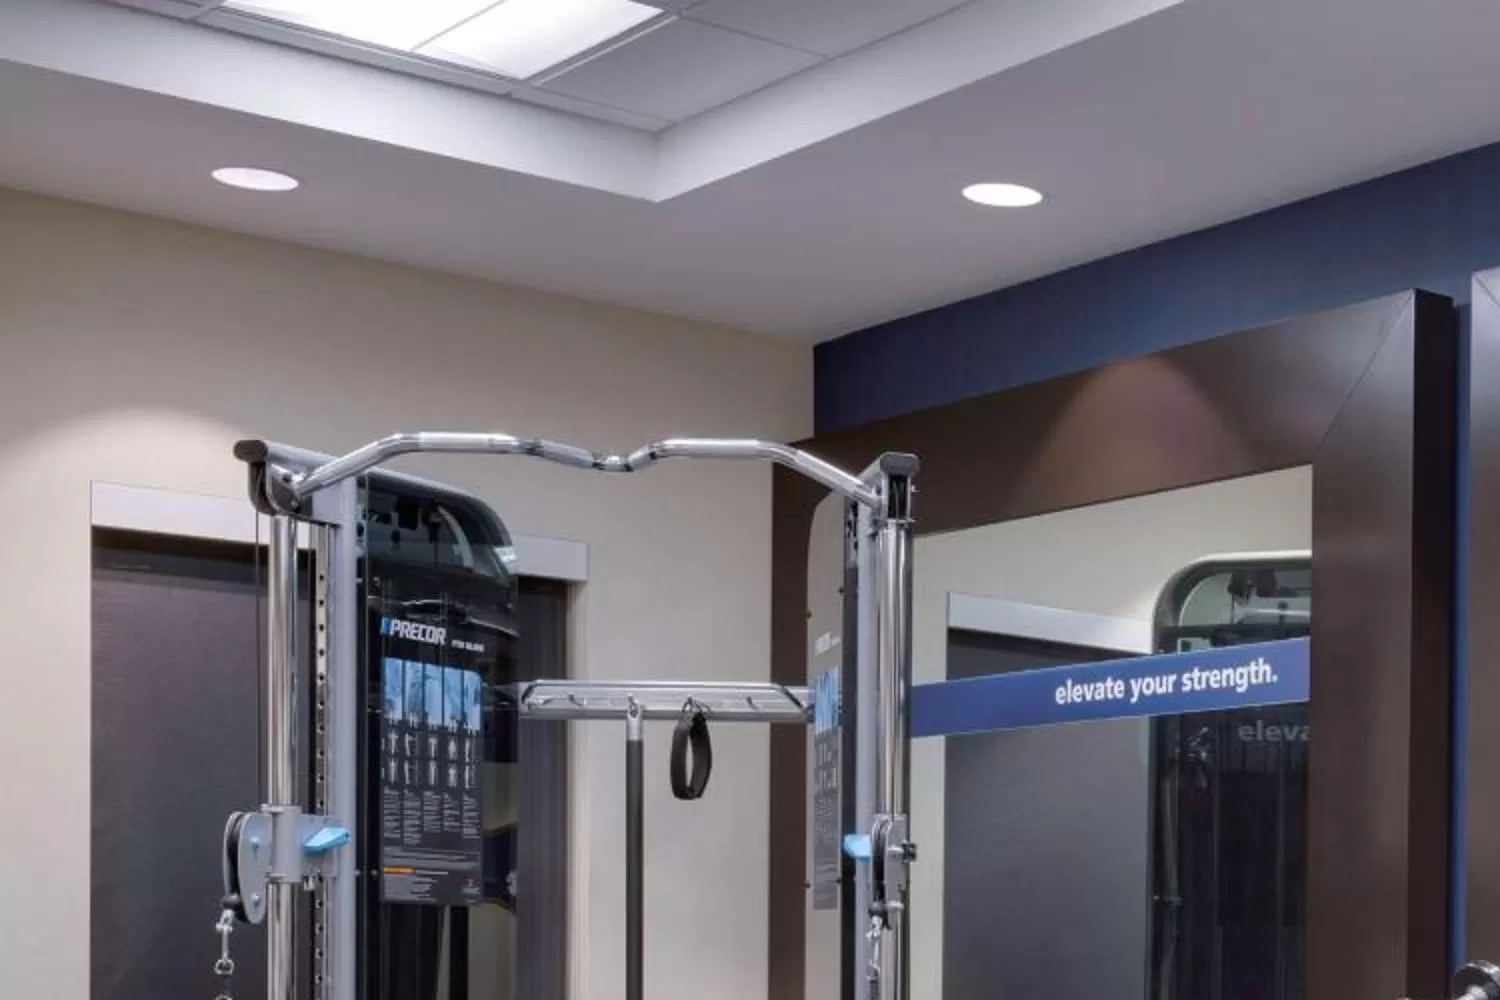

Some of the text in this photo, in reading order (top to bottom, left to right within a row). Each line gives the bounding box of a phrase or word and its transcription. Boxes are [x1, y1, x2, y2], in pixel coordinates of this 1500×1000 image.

[390, 619, 447, 645] PRECOR
[1055, 658, 1279, 705] elevate your strength.
